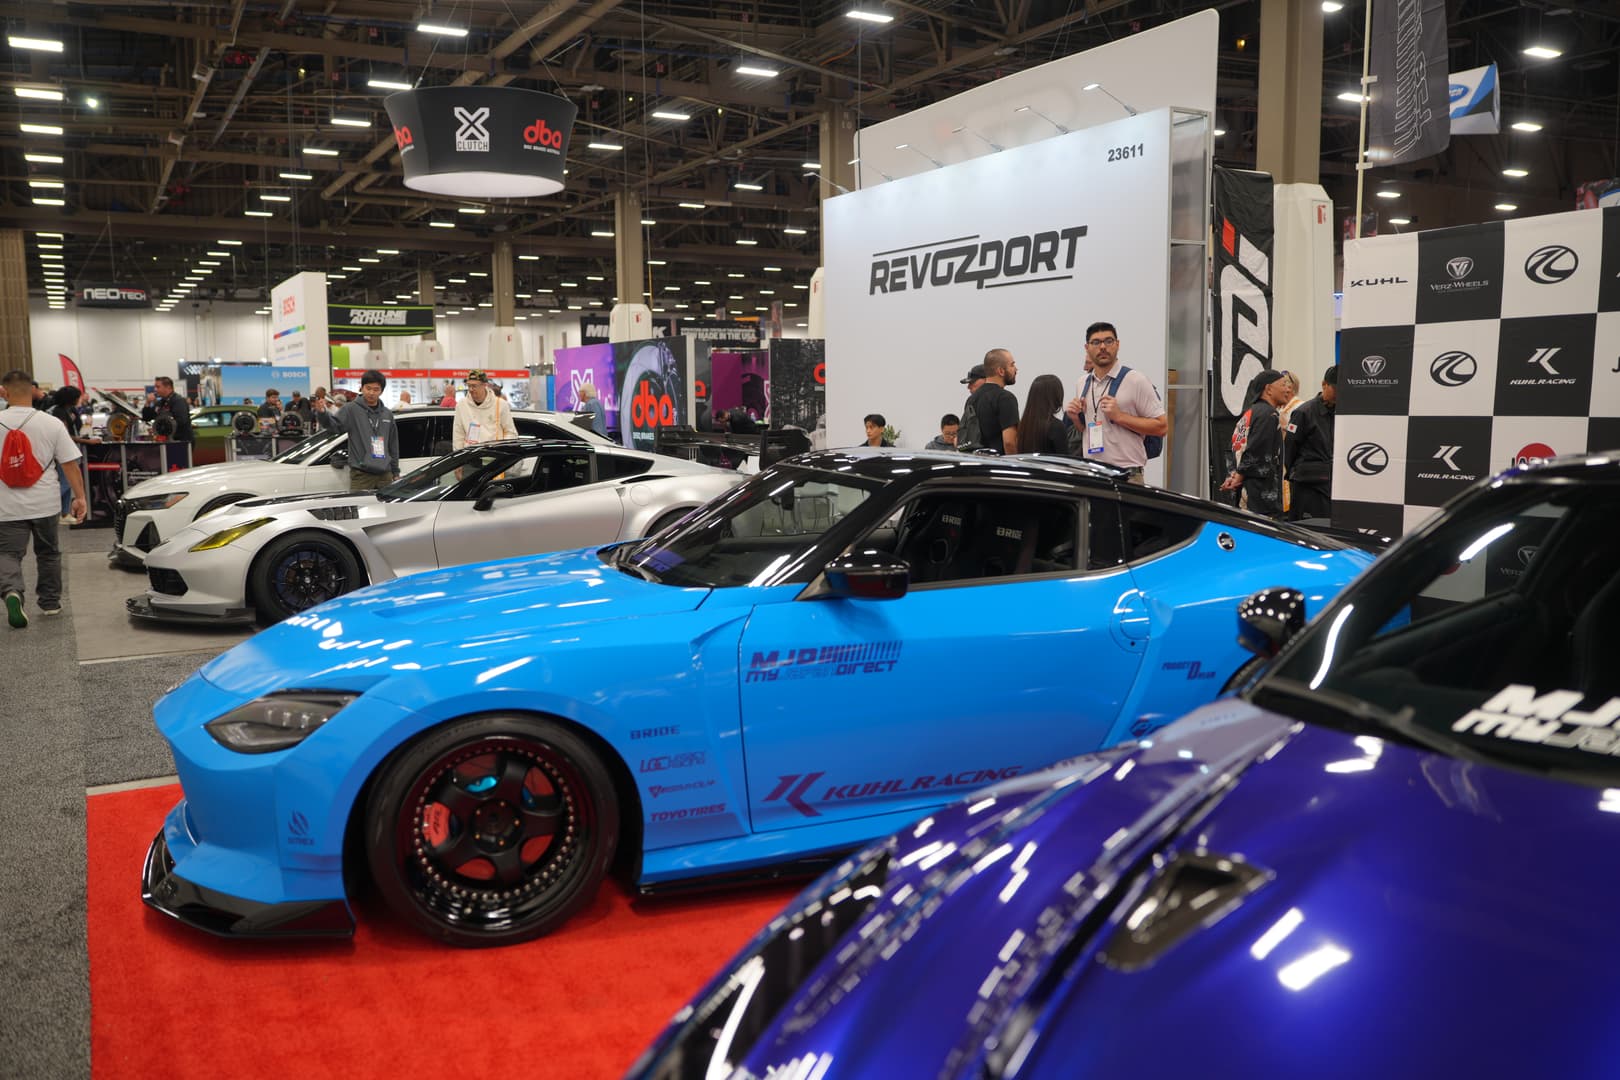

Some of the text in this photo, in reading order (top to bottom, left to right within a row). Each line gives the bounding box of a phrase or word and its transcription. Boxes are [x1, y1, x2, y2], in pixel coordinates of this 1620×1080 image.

[523, 119, 562, 149] dba
[456, 140, 489, 151] CLUTCH
[1107, 143, 1144, 162] 23611
[1351, 276, 1408, 287] KUHL
[350, 309, 408, 317] FORTUNE
[350, 316, 385, 325] AUTO
[1509, 378, 1576, 386] KUHL RACING
[631, 379, 673, 428] dba
[1417, 472, 1476, 481] KUHL RACING
[630, 725, 680, 739] BRIDE
[822, 765, 1024, 801] KUHL RACING
[650, 802, 726, 822] TOYO TIRES
